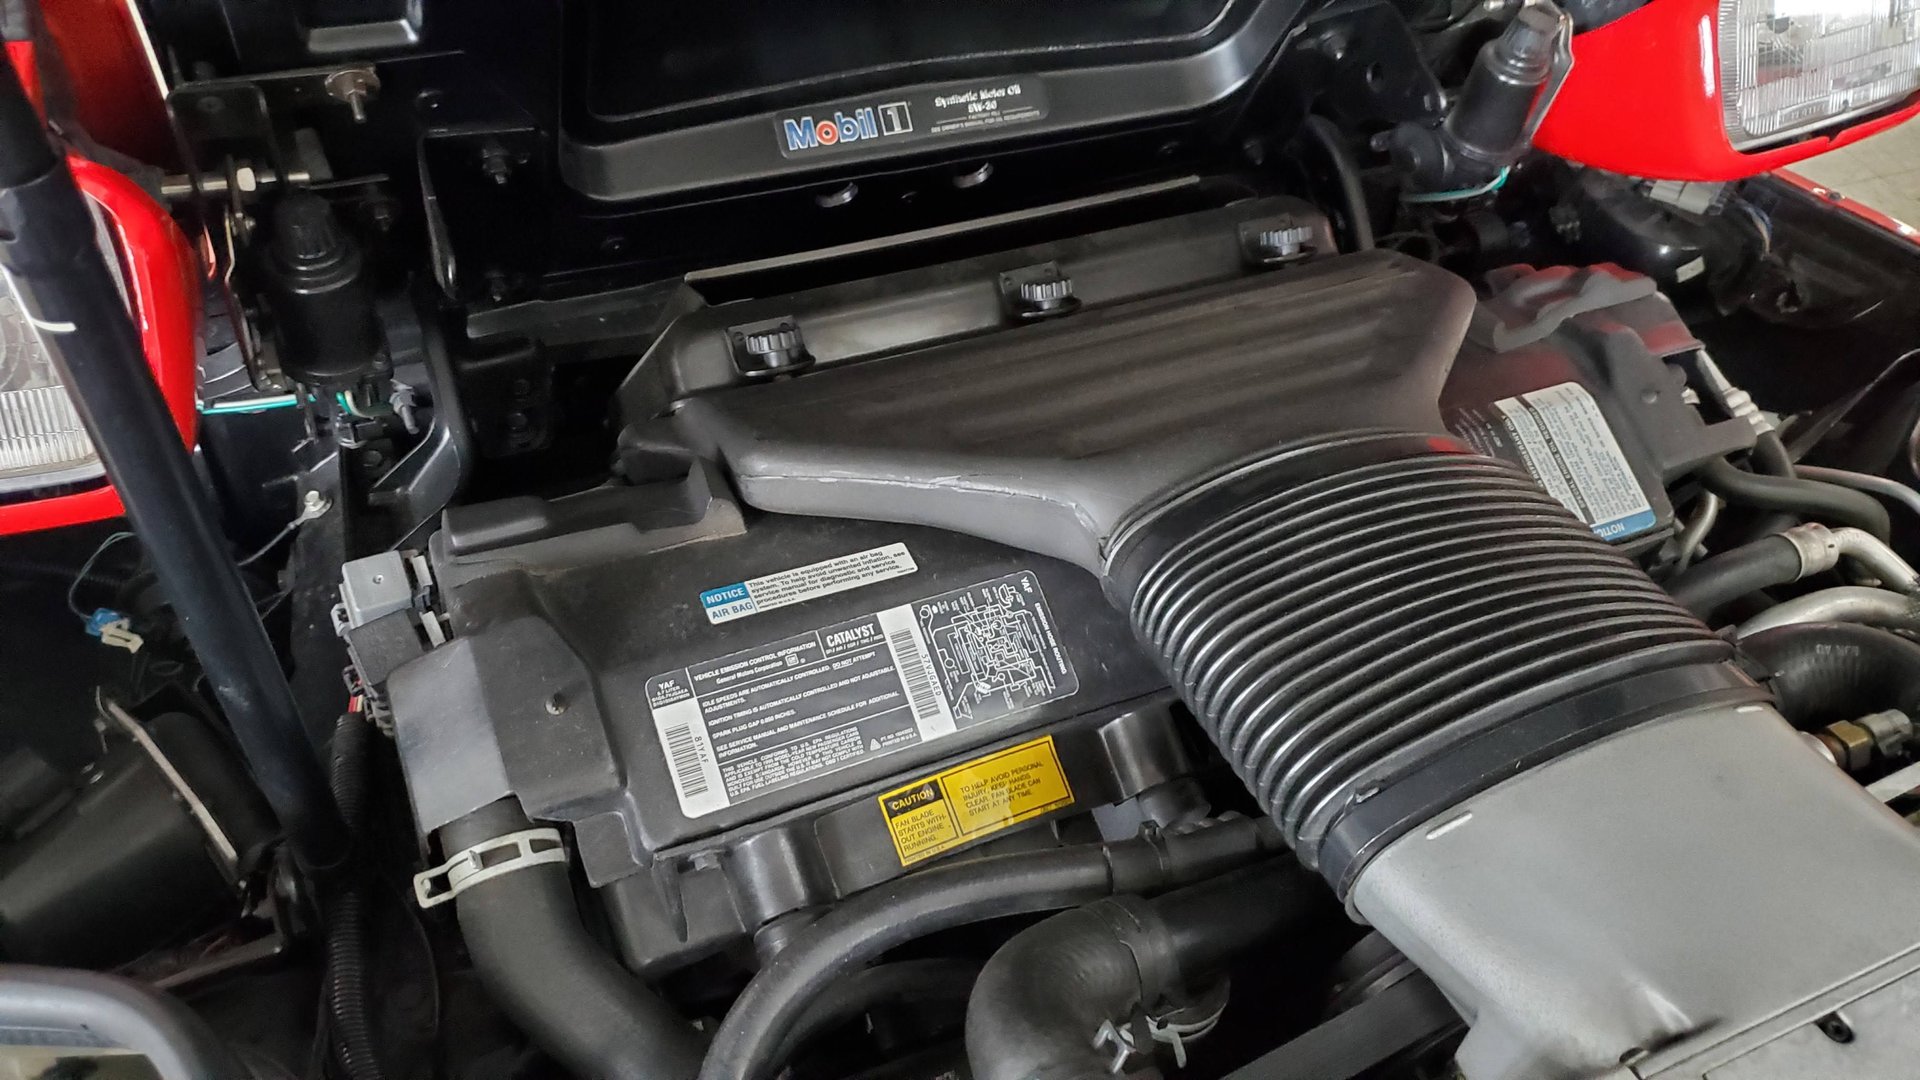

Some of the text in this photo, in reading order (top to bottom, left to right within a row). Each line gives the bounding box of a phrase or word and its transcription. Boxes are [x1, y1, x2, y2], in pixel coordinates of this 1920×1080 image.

[935, 85, 1021, 108] Synthetic Motor Oil
[785, 108, 877, 150] Mobil
[1529, 408, 1552, 439] REQUIRED
[1549, 441, 1557, 452] OIL
[1555, 454, 1570, 478] ENGINE
[1569, 481, 1586, 508] SPECIAL
[1594, 523, 1625, 537] NOTIC
[751, 584, 779, 593] system.
[808, 570, 827, 579] avoid
[828, 562, 861, 574] unwanted
[862, 555, 892, 565] inflation,
[754, 590, 780, 599] service
[781, 581, 807, 591] manual
[820, 570, 856, 582] diagnostic
[871, 560, 896, 569] service
[766, 574, 791, 583] vehicle
[800, 563, 832, 575] equipped
[1021, 577, 1032, 592] YAF
[706, 588, 744, 604] NOTICE
[756, 591, 797, 605] procedures
[798, 585, 821, 593] before
[822, 575, 860, 588] performing
[875, 565, 901, 574] service.
[712, 602, 753, 619] AIR BAG
[826, 624, 874, 645] CATALYST
[1035, 603, 1049, 630] EMISSION
[1046, 630, 1056, 647] HOSE
[1053, 647, 1067, 674] ROUTING
[694, 669, 720, 681] VEHICLE
[720, 661, 748, 674] EMISSION
[749, 653, 777, 665] CONTROL
[777, 642, 816, 657] INFORMATION
[716, 661, 783, 684] General Motors Corporation
[658, 680, 674, 690] YAF
[702, 699, 715, 707] IDLE
[716, 693, 738, 703] SPEEDS
[751, 676, 793, 693] AUTOMATICALLY
[794, 666, 830, 680] CONTROLLED.
[853, 652, 875, 663] ATTEMPT
[705, 697, 746, 713] ADJUSTMENTS.
[708, 715, 733, 726] IGNITION
[733, 709, 752, 718] TIMING
[759, 694, 802, 710] AUTOMATICALLY
[803, 683, 838, 697] CONTROLLED
[862, 666, 894, 680] ADJUSTABLE.
[712, 729, 731, 739] SPARK
[732, 724, 747, 733] PLUG
[774, 709, 796, 719] INCHES.
[729, 736, 752, 748] SERVICE
[753, 730, 776, 740] MANUAL
[789, 713, 826, 728] MAINTENANCE
[827, 704, 855, 717] SCHEDULE
[869, 691, 899, 704] ADDITIONAL
[694, 736, 709, 763] 81YAF
[719, 743, 757, 758] INFORMATION.
[960, 761, 1044, 794] TO HELP AVOID PERSONAL
[991, 790, 1005, 800] FAN
[1028, 777, 1041, 787] CAN
[1009, 773, 1031, 785] HANDS
[891, 788, 934, 810] CAUTION
[969, 804, 990, 816] START
[992, 800, 1000, 808] AT
[1001, 794, 1015, 804] ANY
[895, 809, 934, 829] FAN BLADE
[898, 814, 946, 836] STARTS WITH-
[901, 823, 944, 844] OUT ENGINE
